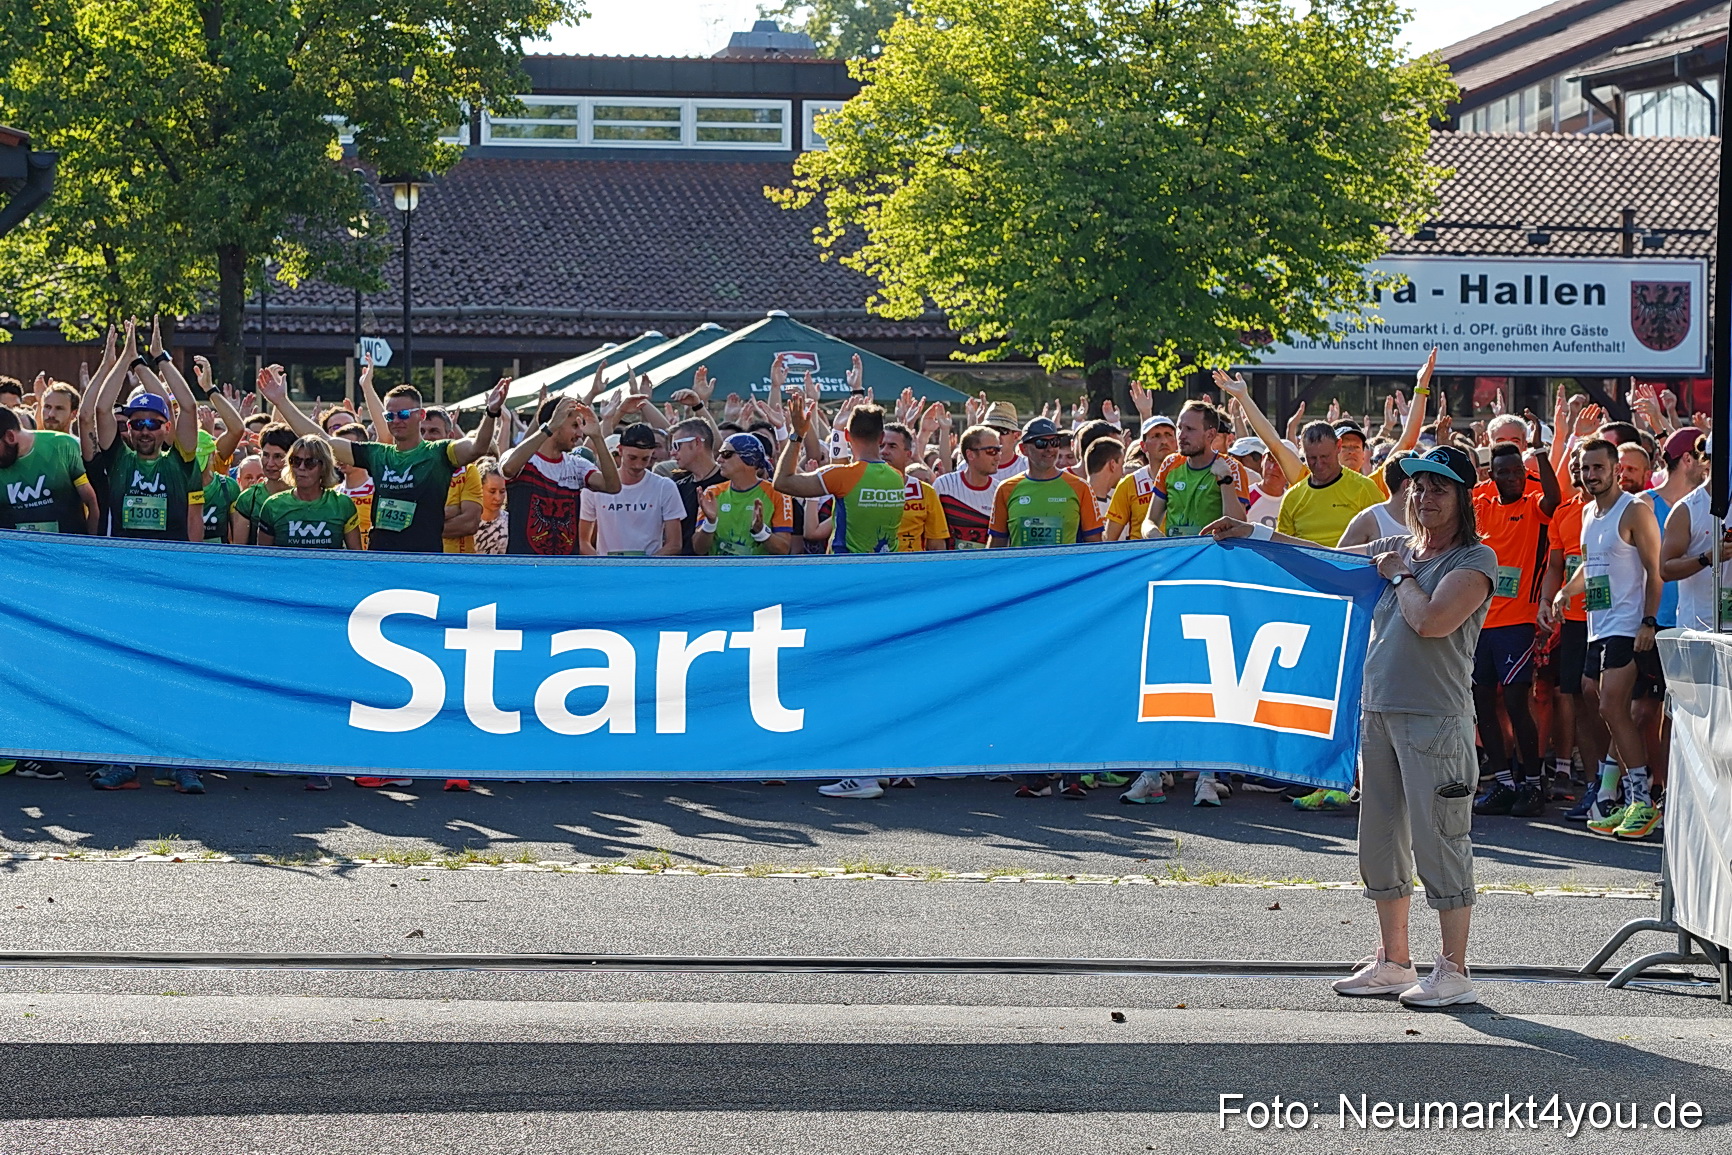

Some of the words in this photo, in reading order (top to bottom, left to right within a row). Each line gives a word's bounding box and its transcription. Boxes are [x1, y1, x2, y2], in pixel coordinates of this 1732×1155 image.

[1460, 273, 1606, 306] Hallen
[1373, 323, 1438, 336] Neumarkt
[1453, 323, 1465, 336] d.
[1469, 323, 1498, 336] OPf.
[1502, 324, 1537, 339] grüßt
[1541, 325, 1567, 336] ihre
[1570, 324, 1609, 337] Gäste
[363, 340, 382, 362] WC
[1382, 340, 1419, 352] Ihnen
[1423, 340, 1459, 353] einen
[1463, 341, 1549, 355] angenehmen
[1552, 341, 1626, 353] Aufenthalt!
[763, 376, 844, 384] Nmrkter
[130, 507, 160, 519] 1308
[608, 502, 647, 512] APTIV
[381, 509, 407, 522] 1435
[1030, 526, 1052, 538] 622
[301, 537, 332, 545] ENERGIE
[1499, 576, 1513, 588] 77
[347, 588, 807, 736] Start
